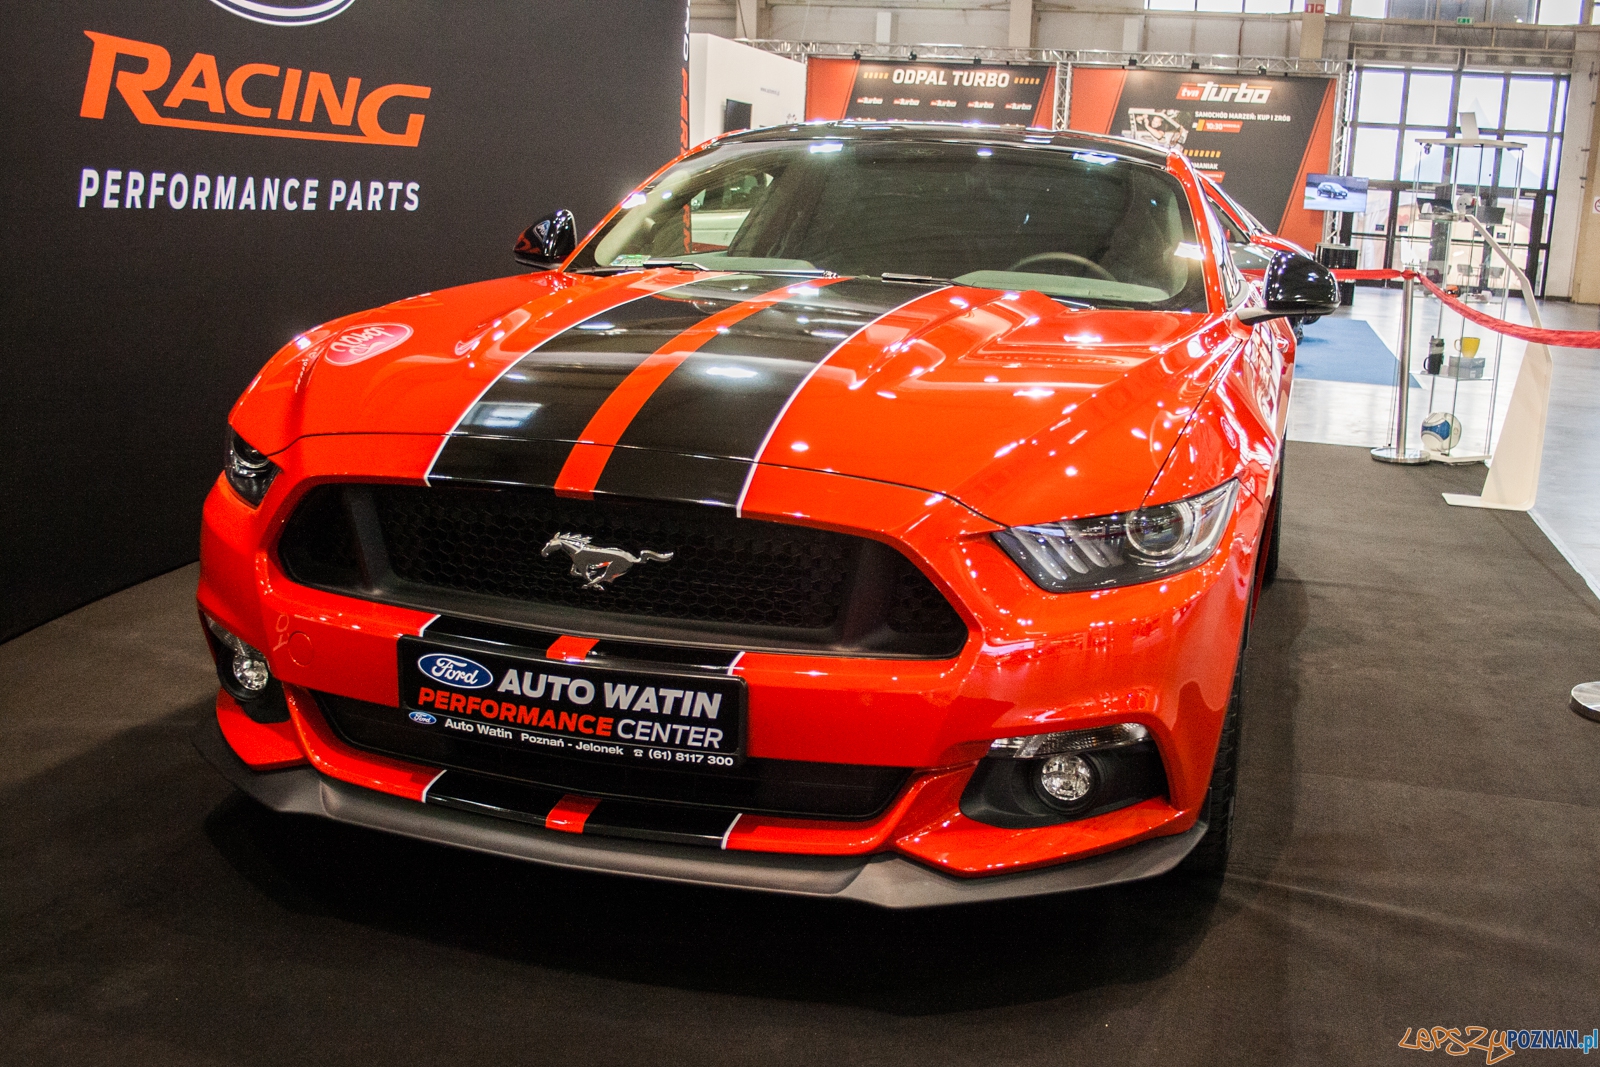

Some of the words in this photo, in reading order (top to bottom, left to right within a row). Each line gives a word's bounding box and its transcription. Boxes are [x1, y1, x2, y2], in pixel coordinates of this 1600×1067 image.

[80, 30, 432, 148] RACING
[892, 69, 947, 86] ODPAL
[952, 70, 1010, 88] TURBO
[79, 168, 319, 211] PERFORMANCE
[329, 179, 421, 211] PARTS
[431, 657, 479, 685] Ford
[497, 668, 596, 705] AUTO
[603, 682, 723, 719] WATIN
[417, 687, 614, 737] PERFORMANCE
[617, 718, 724, 749] CENTER
[444, 718, 475, 732] Auto
[476, 724, 513, 739] Watin
[521, 732, 565, 748] Poznań
[575, 741, 625, 756] Jelonek
[648, 748, 672, 761] (61)
[675, 752, 704, 763] 8117
[707, 755, 734, 766] 300
